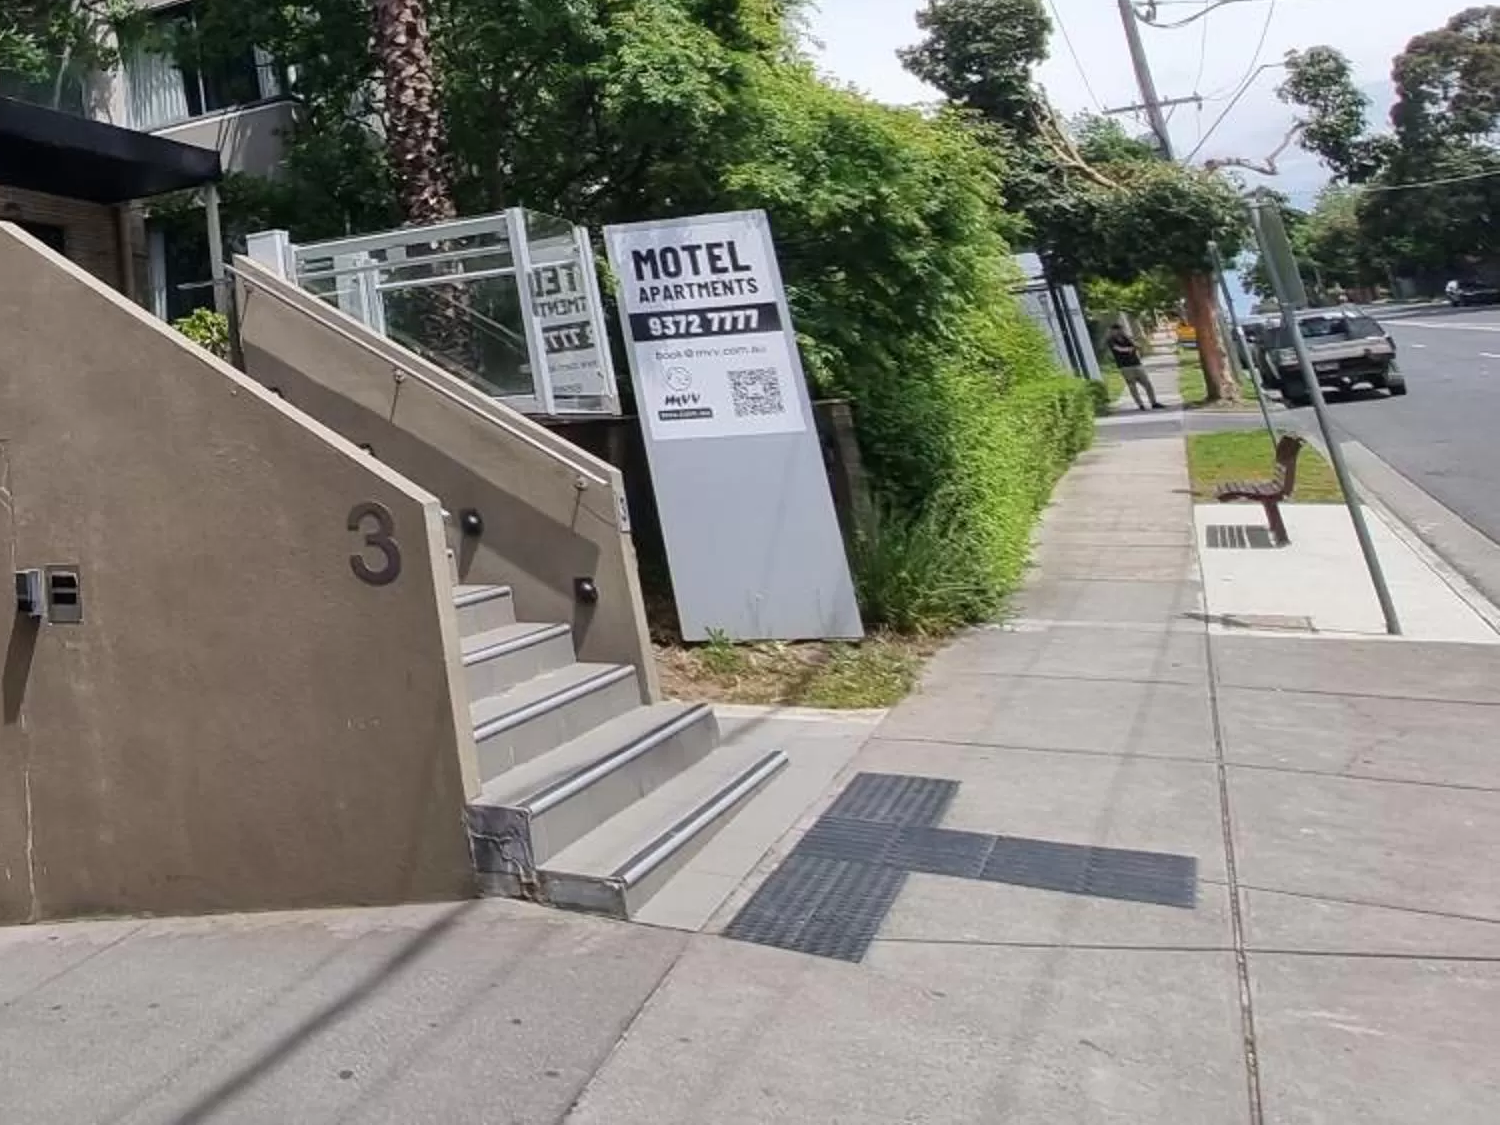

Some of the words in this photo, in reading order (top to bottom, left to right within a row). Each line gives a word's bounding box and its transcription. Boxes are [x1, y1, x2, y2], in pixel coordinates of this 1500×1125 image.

[631, 240, 752, 282] MOTEL
[638, 276, 759, 304] APARTMENTS
[648, 314, 703, 336] 9372
[706, 309, 759, 332] 7777
[347, 501, 401, 587] 3
